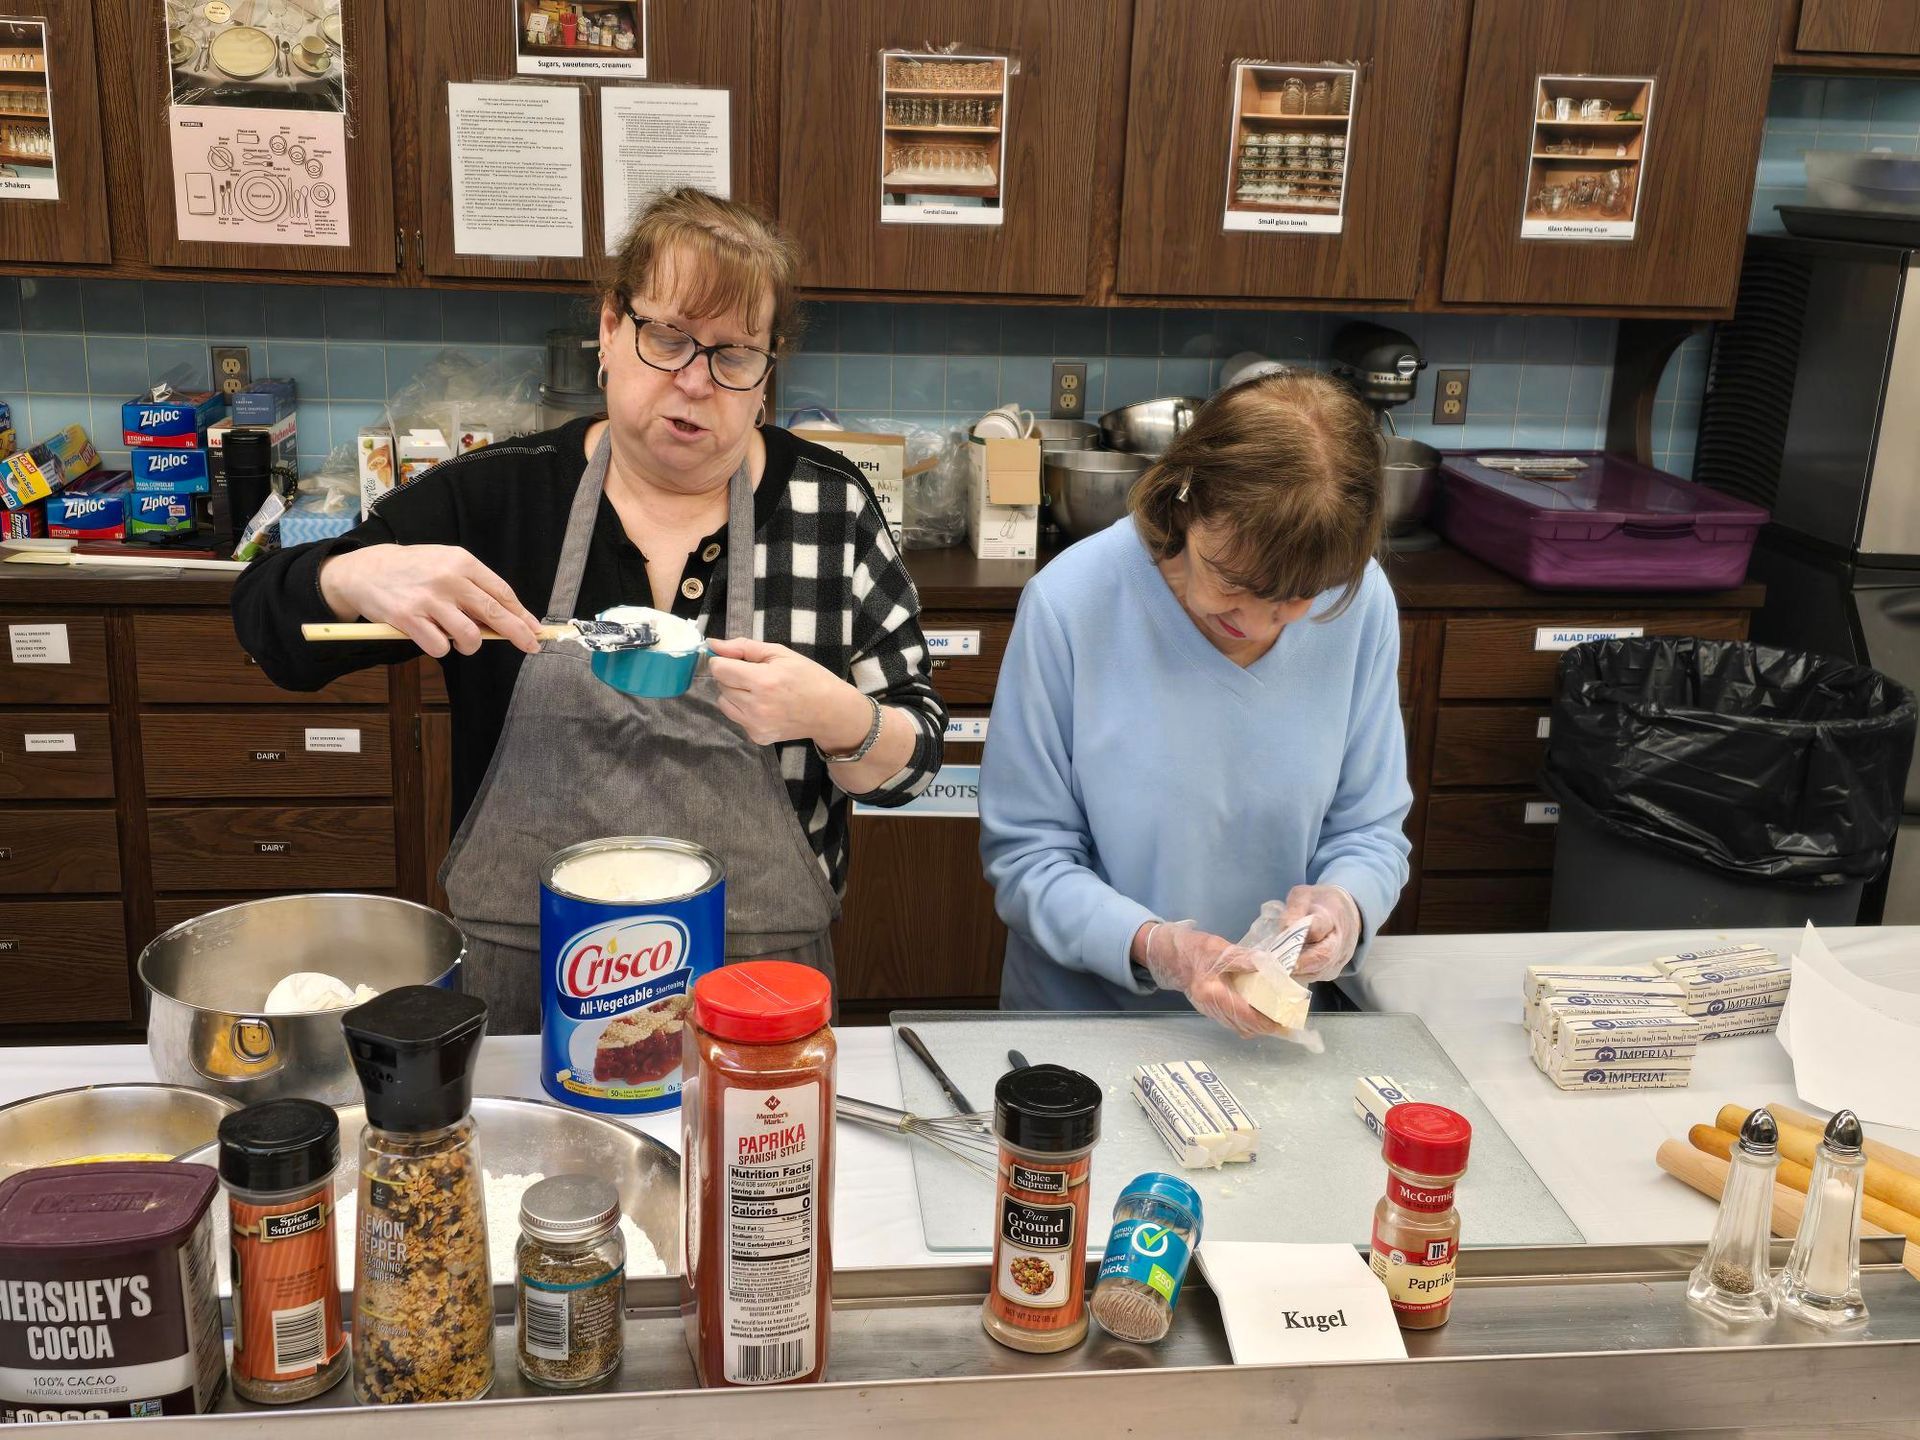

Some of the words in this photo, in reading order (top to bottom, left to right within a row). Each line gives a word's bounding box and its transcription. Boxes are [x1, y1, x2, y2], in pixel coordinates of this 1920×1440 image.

[537, 60, 560, 68] Sugars,
[562, 61, 600, 69] sweeteners,
[4, 181, 31, 189] Shakers
[1258, 218, 1275, 226] Small
[1564, 225, 1593, 234] Measuring
[140, 409, 180, 427] Ziploc
[18, 454, 36, 474] GLAD
[148, 454, 189, 472] Ziploc
[64, 499, 106, 519] Ziploc
[141, 495, 176, 512] Ziploc
[1553, 633, 1584, 641] SALAD
[256, 752, 280, 760] DAIRY
[261, 844, 284, 852] DAIRY
[568, 939, 672, 998] Crisco
[579, 987, 653, 1015] All-Vegetable
[655, 979, 685, 996] Shortening
[1592, 997, 1651, 1006] IMPERIAL
[1727, 995, 1773, 1010] IMPERIAL
[1615, 1018, 1673, 1028] IMPERIAL
[1618, 1049, 1675, 1059] IMPERIAL
[1609, 1072, 1667, 1083] IMPERIAL
[1207, 1084, 1239, 1117] IMPERIAL
[756, 1112, 788, 1120] Member's
[738, 1123, 805, 1155] PAPRIKA
[738, 1150, 777, 1165] SPANISH
[780, 1141, 806, 1158] STYLE
[731, 1167, 779, 1179] Nutrition
[783, 1164, 811, 1176] Facts
[1024, 1170, 1051, 1183] Spice
[731, 1187, 752, 1195] Serving
[731, 1205, 778, 1215] Calories
[802, 1196, 811, 1208] 0
[280, 1213, 309, 1227] Spice
[1008, 1212, 1064, 1233] Ground
[1022, 1208, 1049, 1222] Pure
[361, 1209, 404, 1240] LEMON
[1114, 1226, 1135, 1235] simply
[1010, 1226, 1059, 1246] Cumin
[359, 1232, 406, 1262] PEPPER
[747, 1240, 786, 1248] Carbohydrate
[1100, 1263, 1130, 1278] picks
[1154, 1270, 1172, 1290] 250
[1408, 1272, 1455, 1293] Paprika
[1282, 1310, 1348, 1332] Kugel
[27, 1325, 115, 1361] COCOA
[33, 1377, 64, 1387] 100%
[67, 1375, 116, 1387] CACAO
[26, 1388, 62, 1396] NATURAL
[65, 1386, 128, 1396] UNSWEETENED
